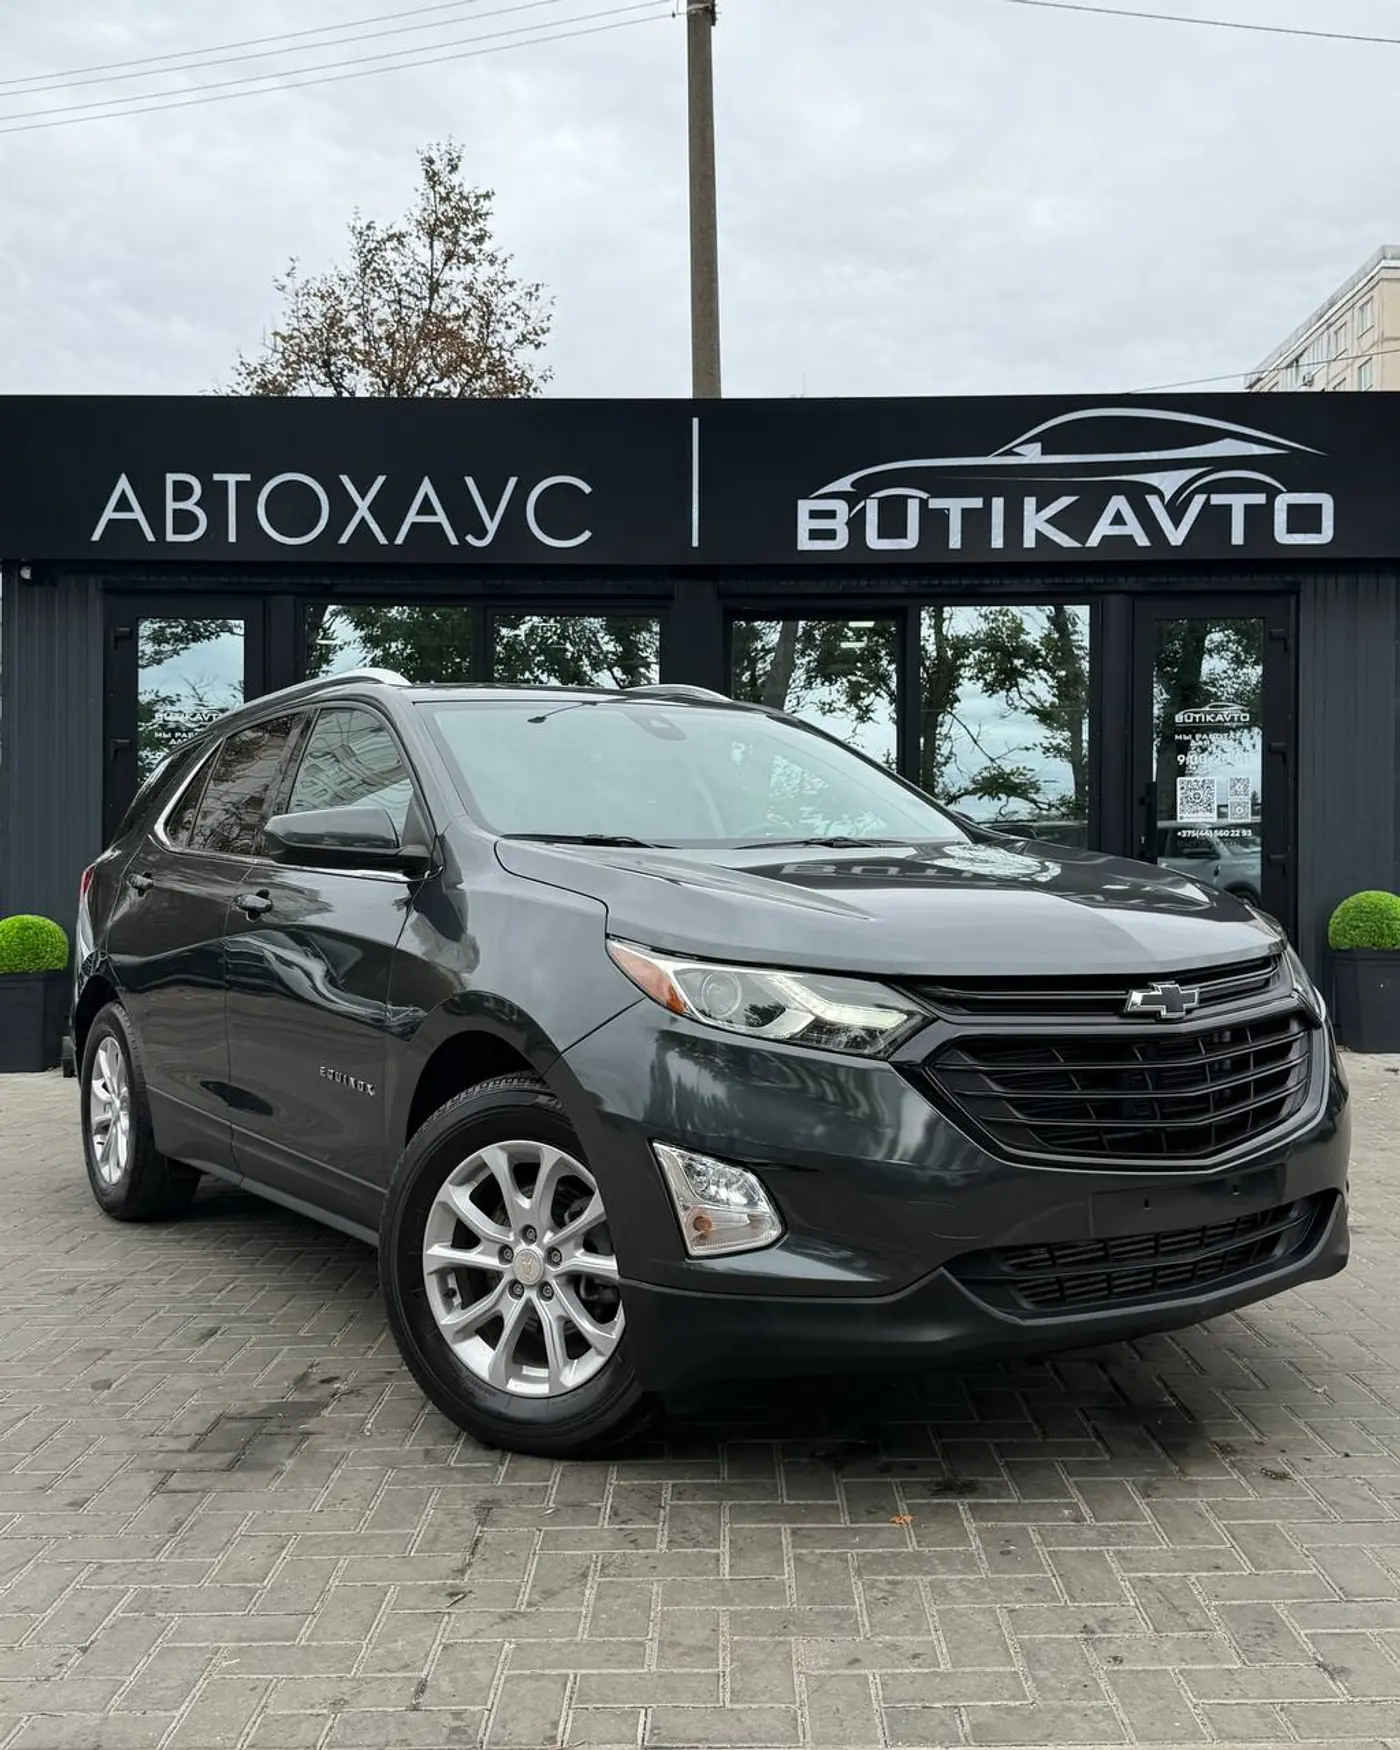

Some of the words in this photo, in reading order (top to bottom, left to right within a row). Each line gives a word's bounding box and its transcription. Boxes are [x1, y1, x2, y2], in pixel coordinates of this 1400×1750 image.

[90, 472, 593, 549] АВТОХАУС
[797, 492, 1334, 551] BUTIKAVTO
[1174, 712, 1250, 723] BUTIKAVTO
